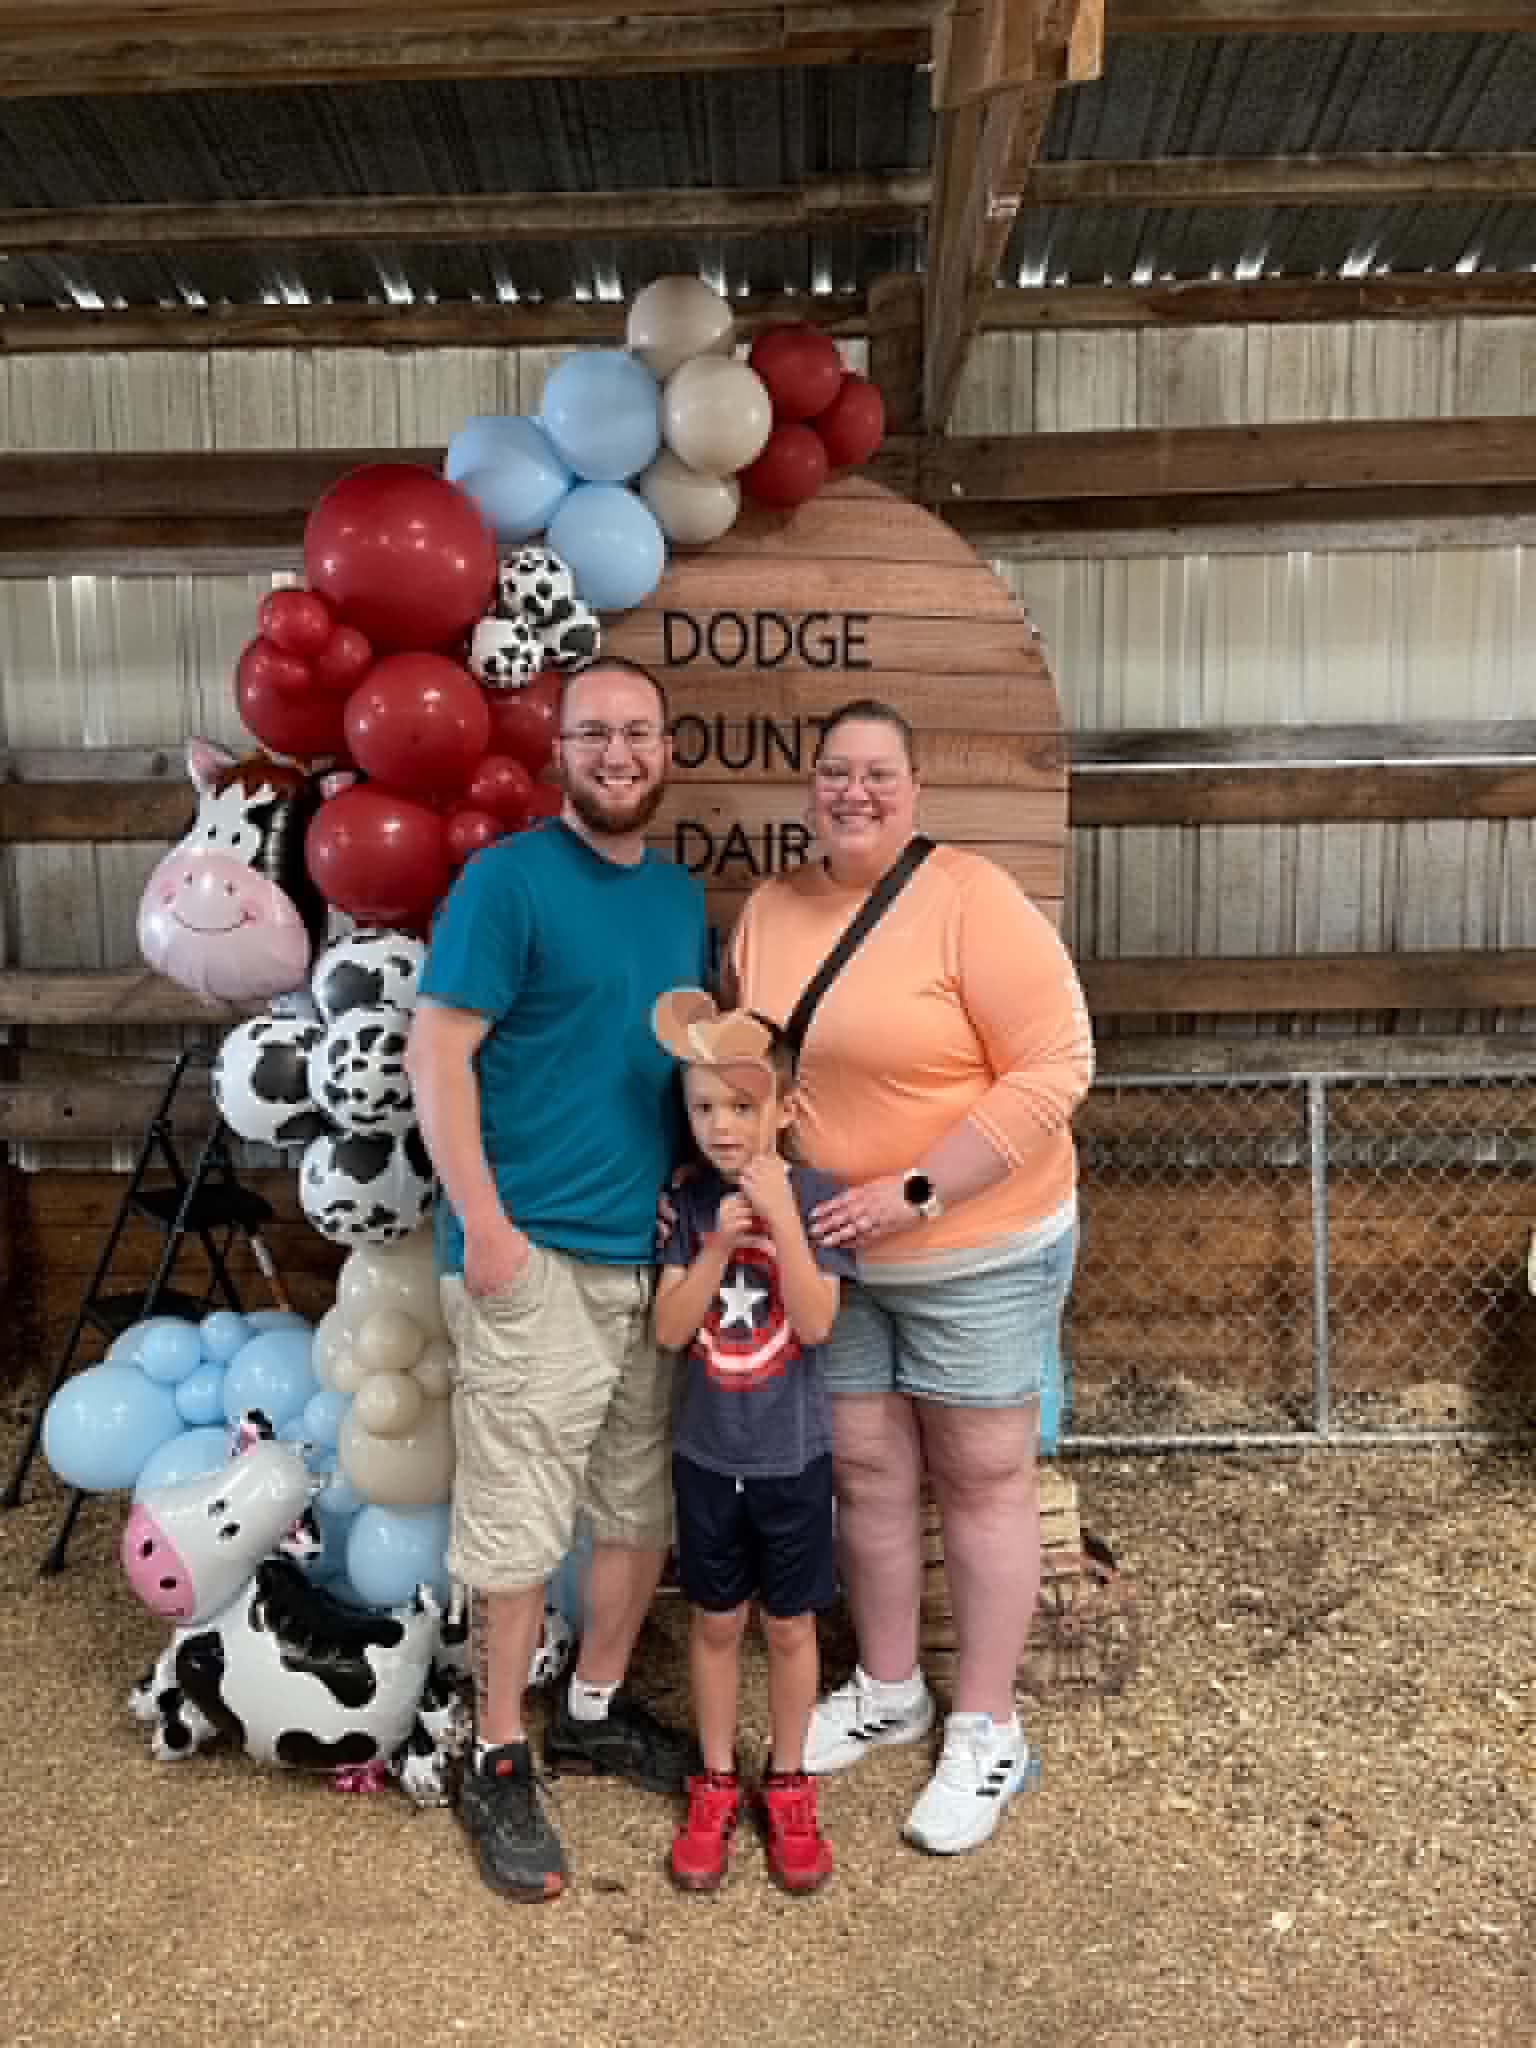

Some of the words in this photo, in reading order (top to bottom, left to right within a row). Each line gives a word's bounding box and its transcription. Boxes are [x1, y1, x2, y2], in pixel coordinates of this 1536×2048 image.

[663, 611, 872, 670] DODGE
[671, 714, 832, 770] OUNT
[675, 821, 816, 876] DAIR
